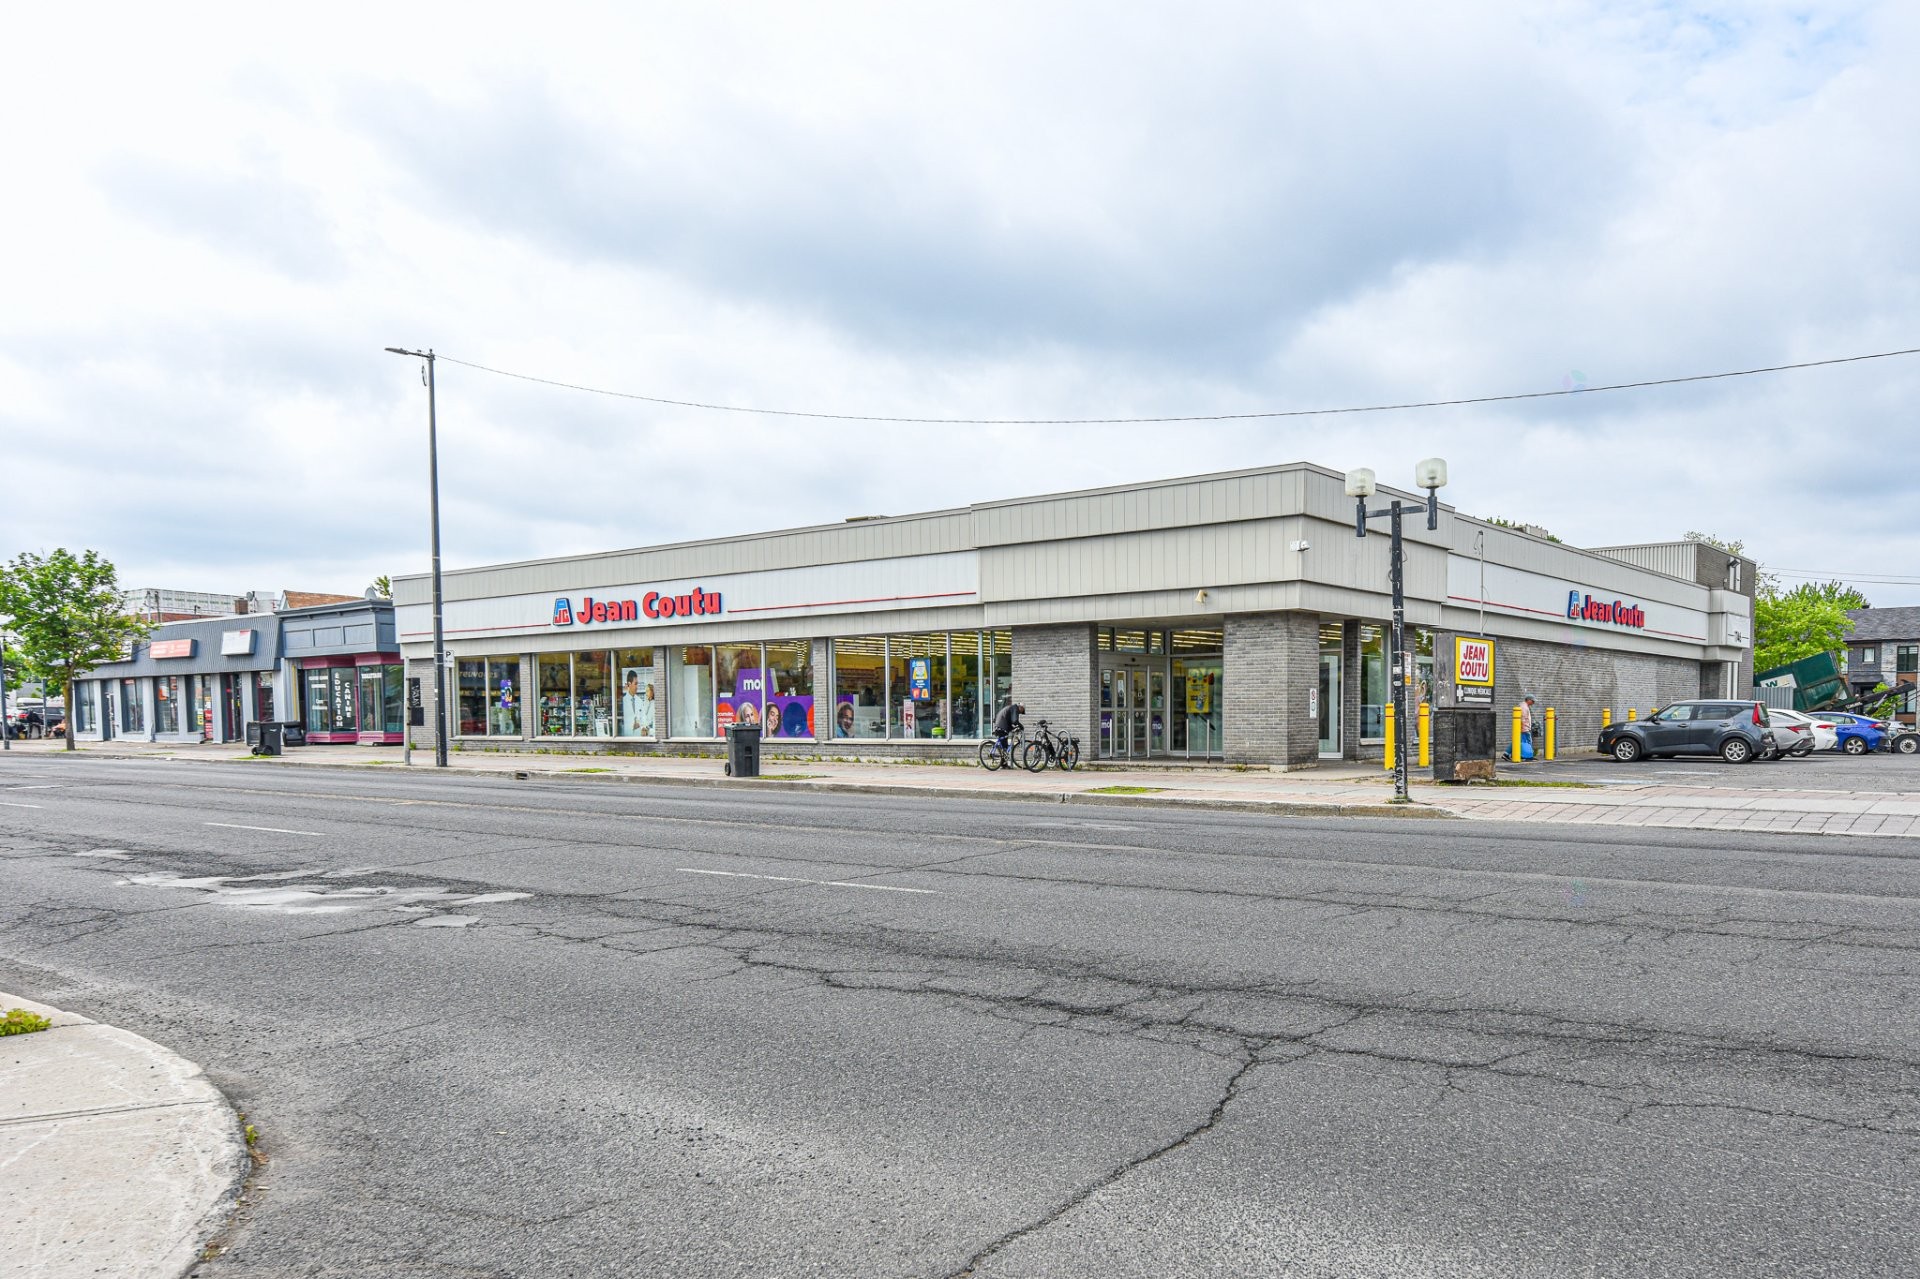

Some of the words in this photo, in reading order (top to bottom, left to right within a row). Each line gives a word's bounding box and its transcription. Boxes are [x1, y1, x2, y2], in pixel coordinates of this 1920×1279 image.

[576, 597, 637, 624] Jean
[643, 586, 722, 618] Coutu
[1581, 595, 1612, 622] Jean
[1613, 600, 1645, 627] Coutu
[1463, 645, 1485, 661] JEAN
[1460, 661, 1488, 678] COUTU
[344, 682, 352, 718] CANINE
